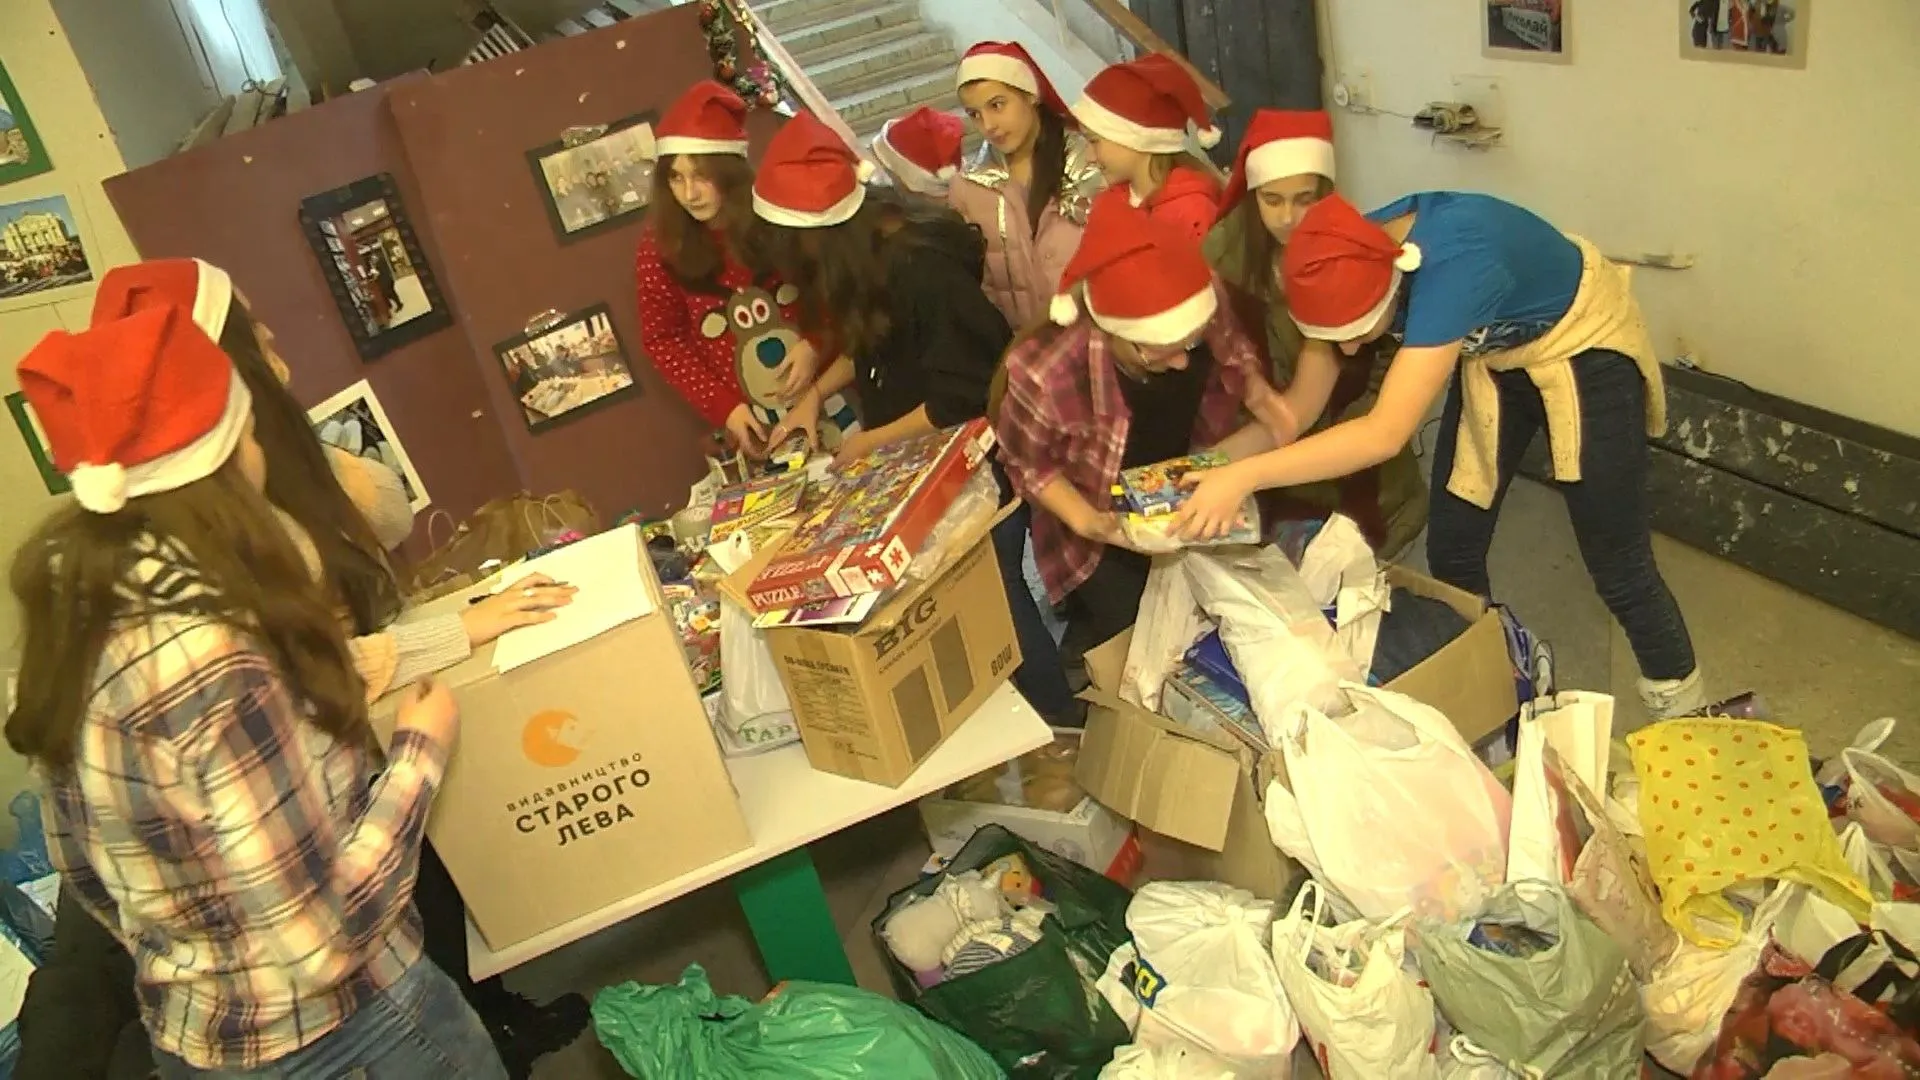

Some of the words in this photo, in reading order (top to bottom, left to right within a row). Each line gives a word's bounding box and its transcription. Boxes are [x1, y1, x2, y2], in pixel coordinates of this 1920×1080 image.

[873, 594, 938, 662] BIG
[515, 768, 651, 834] СТАРОГО
[556, 802, 635, 847] ЛЕВА
